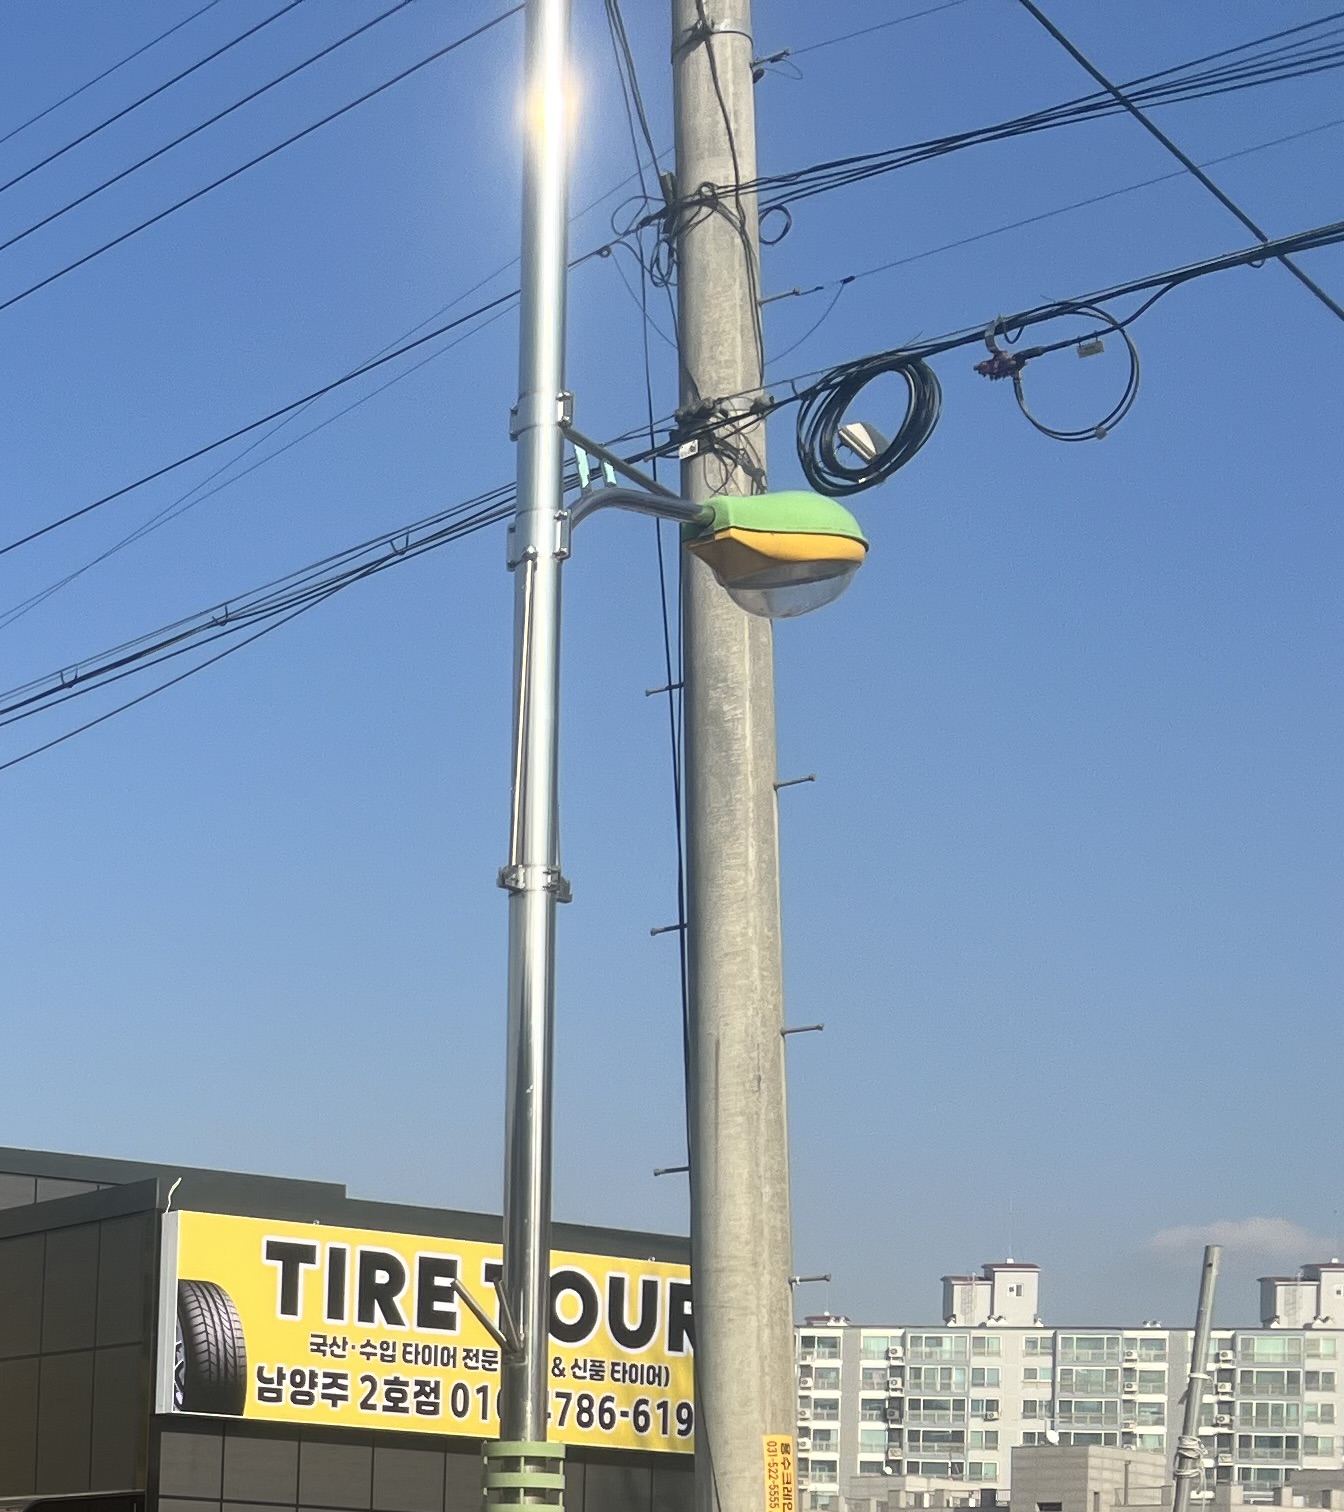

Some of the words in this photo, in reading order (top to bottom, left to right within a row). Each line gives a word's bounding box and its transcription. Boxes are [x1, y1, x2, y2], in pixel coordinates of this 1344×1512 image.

[265, 1240, 459, 1331] TIRE
[256, 1364, 349, 1408] 남양주
[359, 1374, 441, 1416] 2호점
[402, 1342, 457, 1369] 타이어
[462, 1348, 499, 1372] 전문
[570, 1358, 606, 1382] 신품
[610, 1361, 671, 1387] 타이어)
